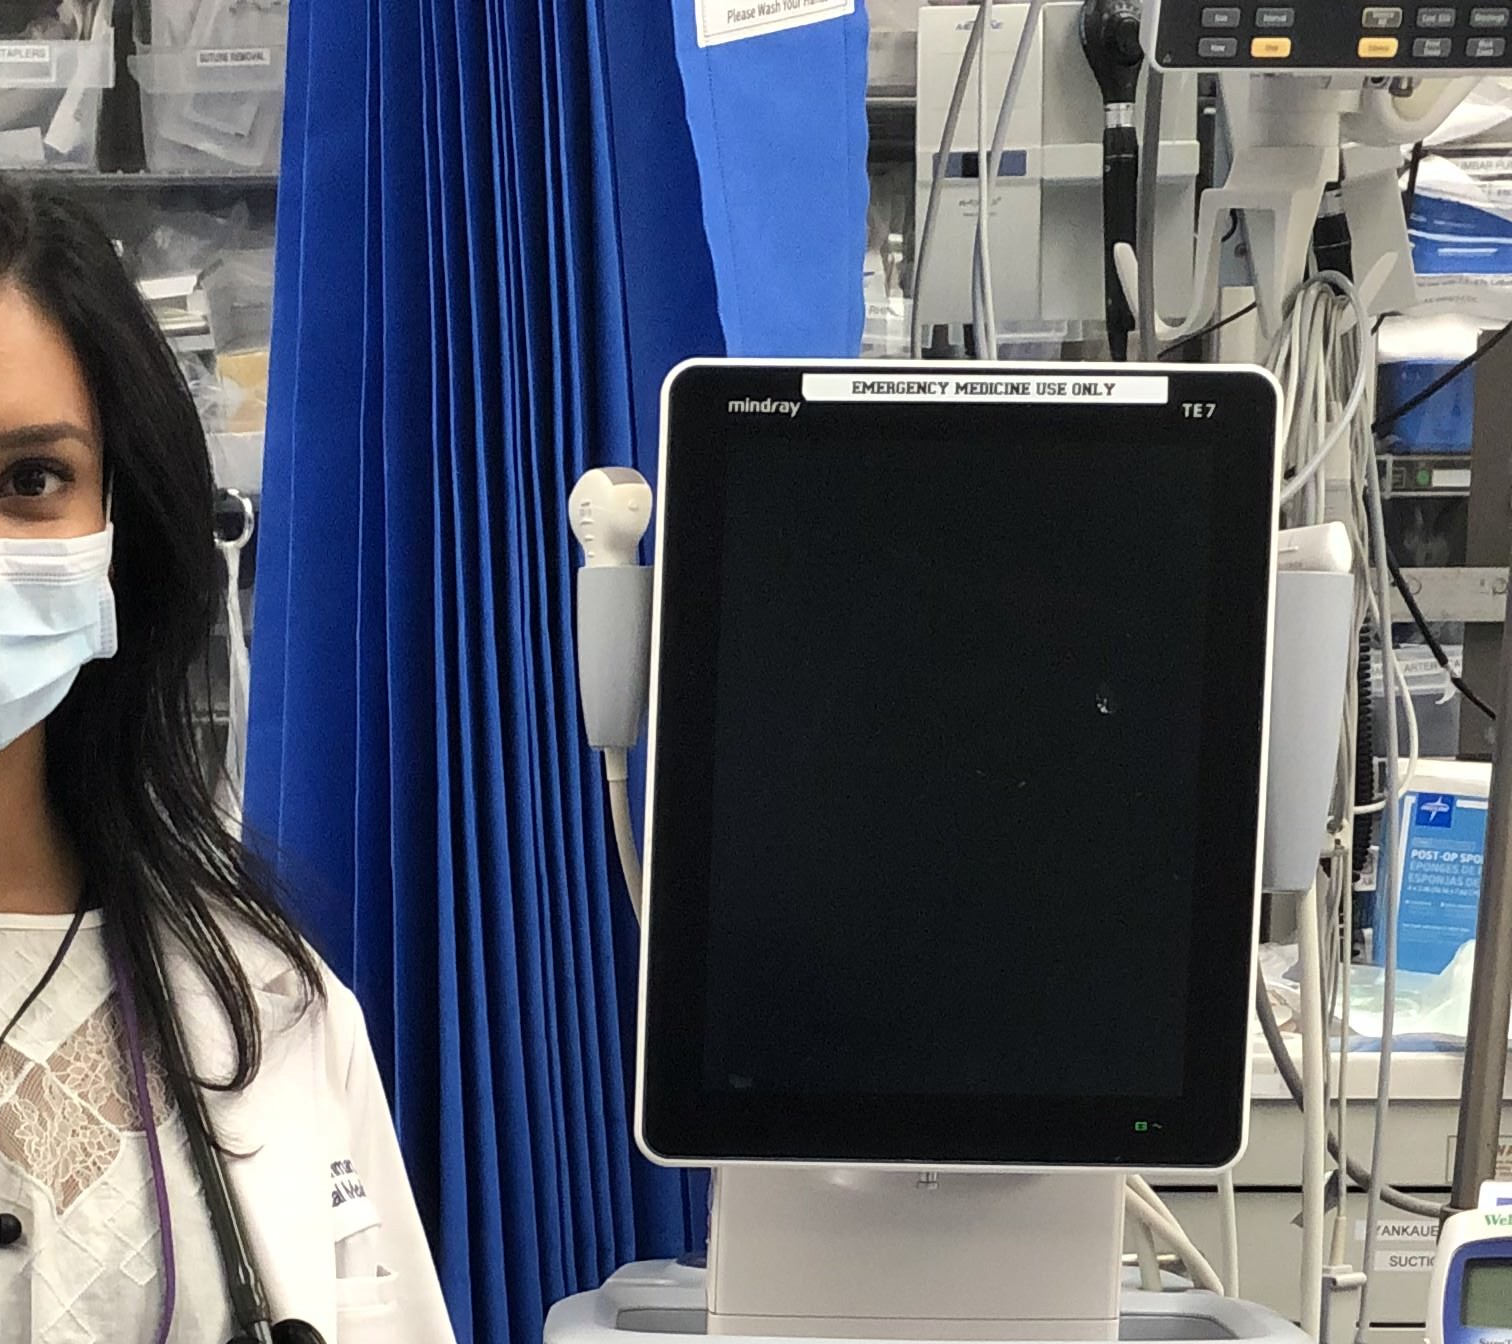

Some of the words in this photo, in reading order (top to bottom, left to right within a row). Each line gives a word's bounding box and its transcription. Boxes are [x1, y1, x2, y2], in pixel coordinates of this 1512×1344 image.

[727, 8, 756, 24] Please
[757, 2, 781, 17] Wash
[1460, 160, 1494, 171] UMBAR
[851, 380, 950, 395] EMERGENCY
[954, 381, 1031, 396] MEDICINE
[1036, 381, 1068, 396] USE
[1071, 381, 1117, 396] ONLY
[727, 396, 802, 419] mindray
[1410, 849, 1458, 862] POST-OP
[1376, 1224, 1439, 1237] ANKAUE
